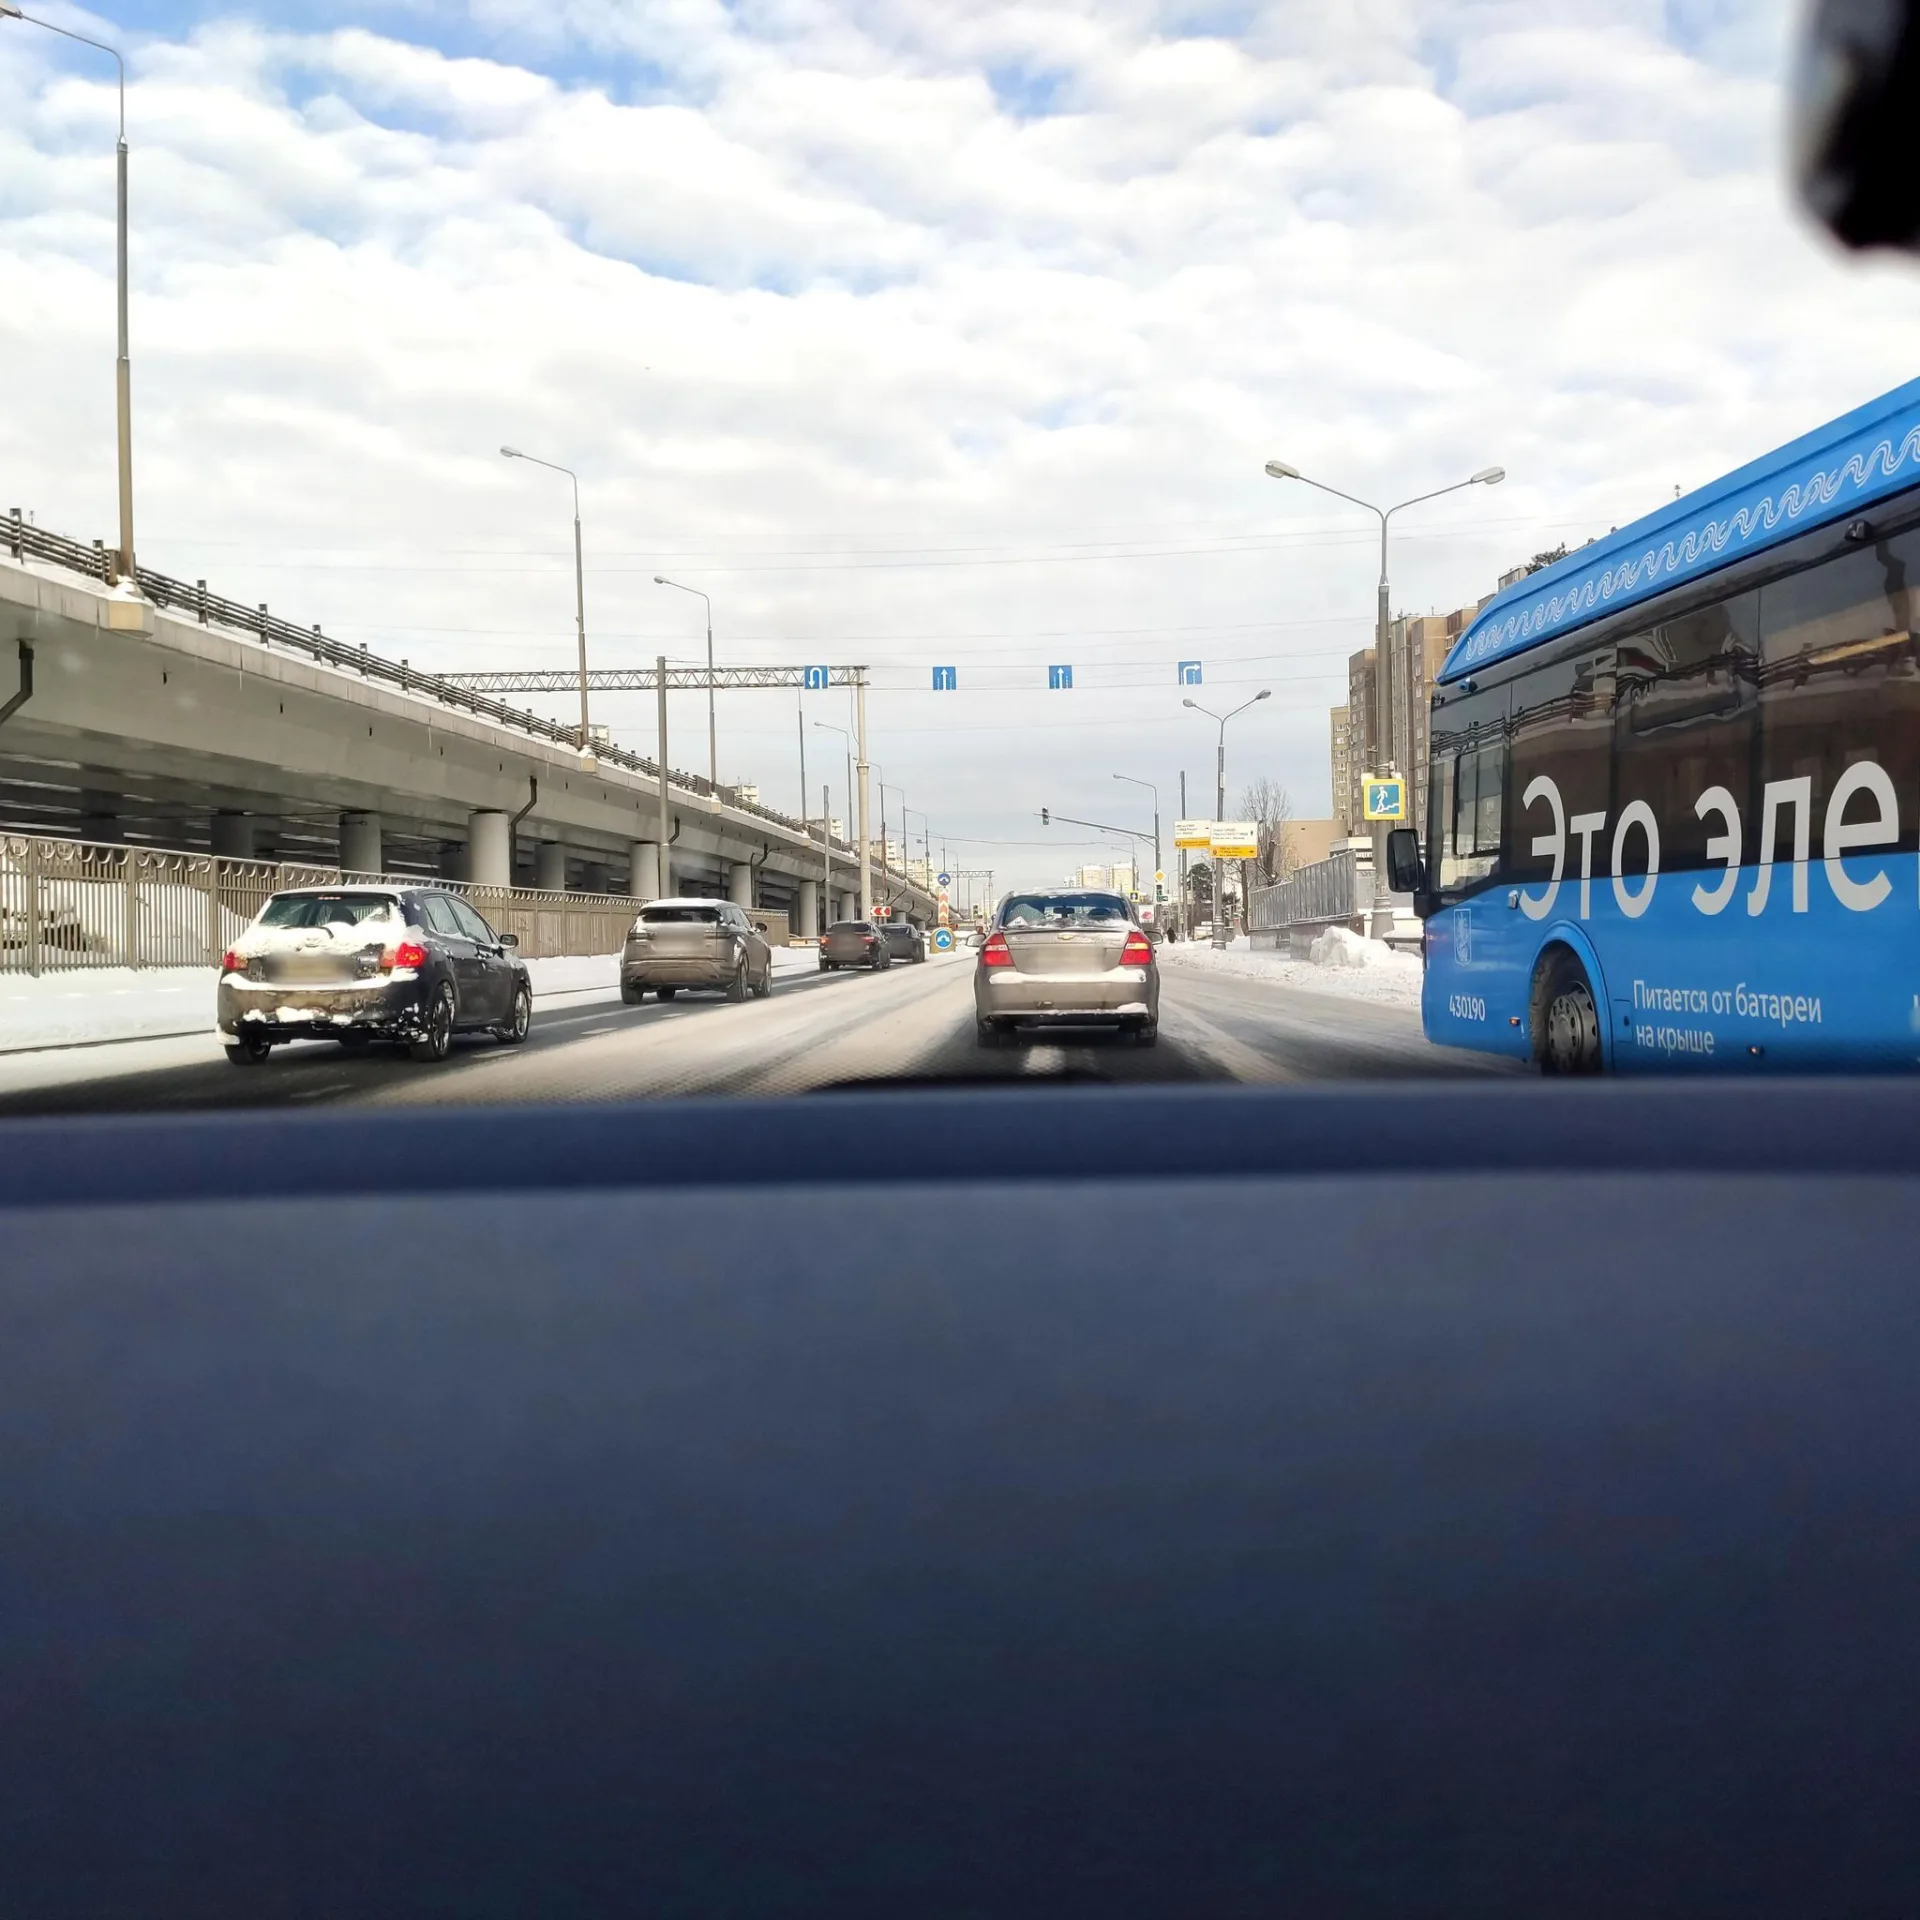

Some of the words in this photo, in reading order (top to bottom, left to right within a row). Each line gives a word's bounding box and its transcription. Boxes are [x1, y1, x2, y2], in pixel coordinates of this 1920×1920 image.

[1519, 775, 1660, 921] Это
[1691, 760, 1920, 917] эле
[1449, 994, 1485, 1021] 430190
[1633, 980, 1708, 1013] Питается
[1712, 990, 1732, 1015] от
[1735, 982, 1822, 1028] батареи
[1636, 1024, 1657, 1048] на
[1657, 1027, 1715, 1057] крыше
